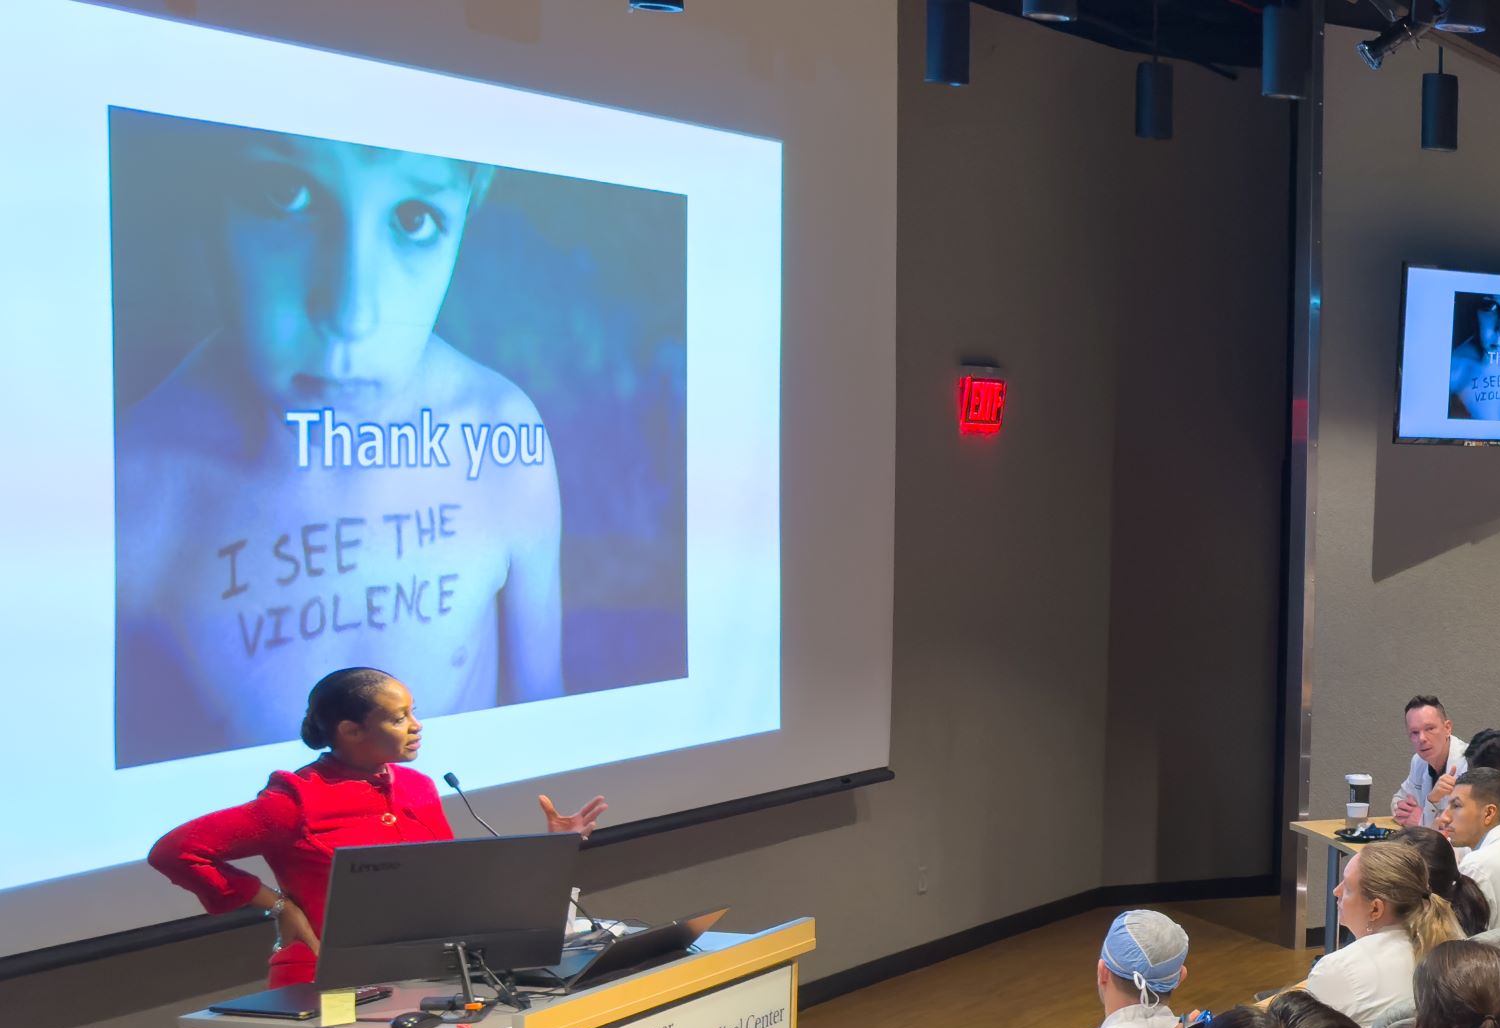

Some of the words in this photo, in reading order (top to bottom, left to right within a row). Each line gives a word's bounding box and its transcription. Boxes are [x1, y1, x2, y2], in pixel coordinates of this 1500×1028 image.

[968, 381, 1003, 421] EXIT
[1471, 377, 1478, 390] I
[285, 407, 450, 469] Thank
[461, 423, 546, 480] you
[217, 539, 248, 600] I
[273, 516, 366, 587] SEE
[382, 503, 462, 560] THE
[238, 573, 459, 660] VIOLENCE
